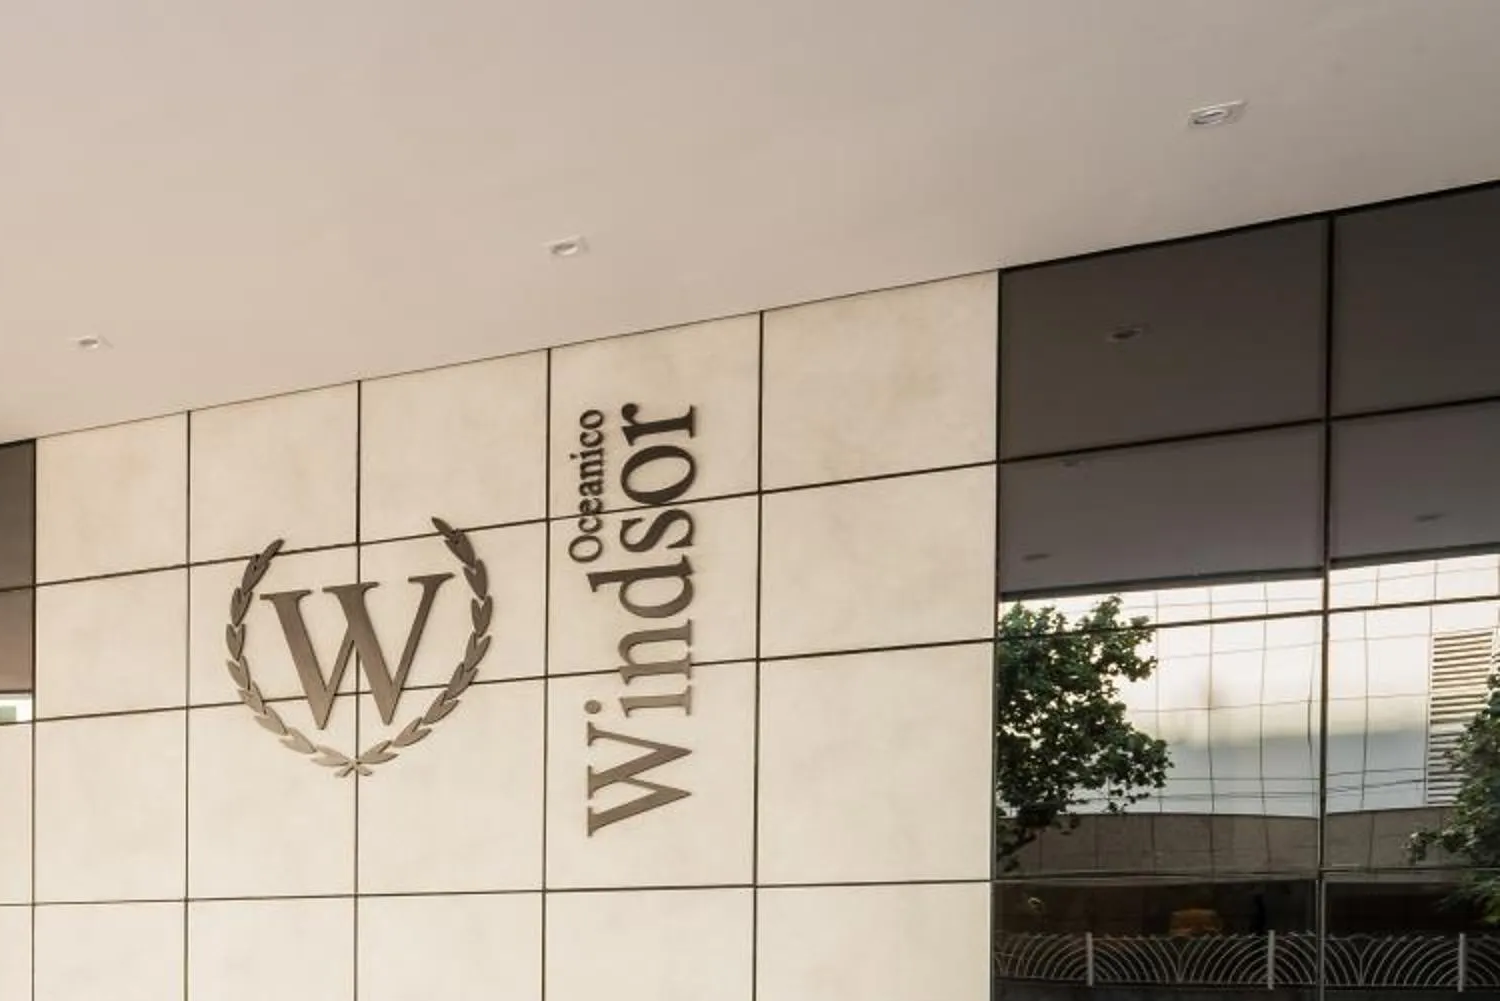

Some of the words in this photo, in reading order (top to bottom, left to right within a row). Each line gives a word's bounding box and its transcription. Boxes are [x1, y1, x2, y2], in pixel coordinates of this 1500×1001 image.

[568, 409, 605, 563] Oceanico
[259, 571, 455, 730] W
[584, 402, 697, 837] Windsor
